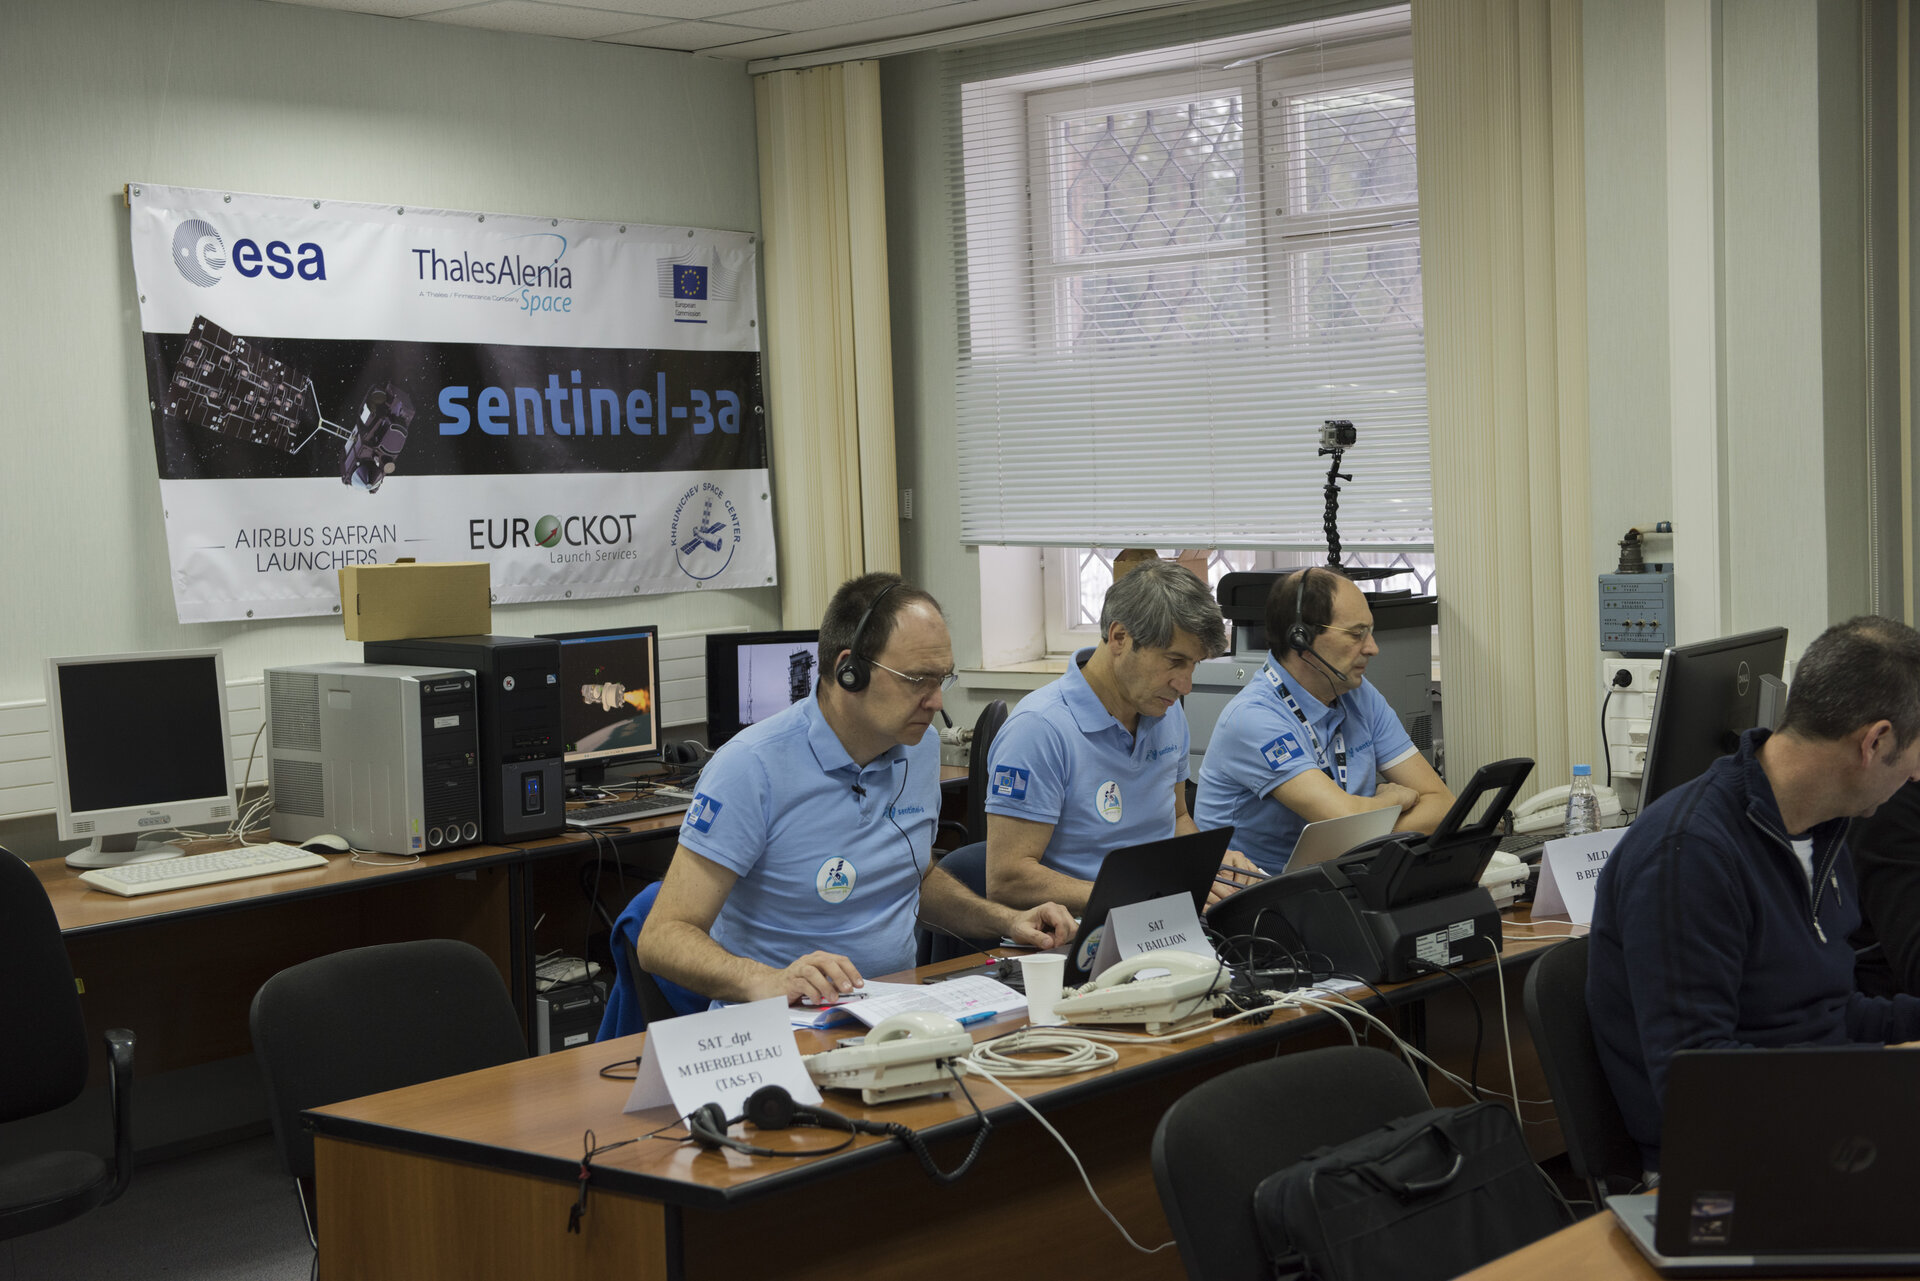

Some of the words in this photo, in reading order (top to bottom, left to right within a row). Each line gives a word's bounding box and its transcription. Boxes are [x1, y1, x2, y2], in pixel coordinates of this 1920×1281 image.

[232, 238, 327, 281] esa
[412, 248, 572, 289] ThalesAlenia
[520, 289, 572, 316] Space
[438, 370, 741, 436] sentinel-3a
[671, 484, 699, 546] KHRUNICHEV
[703, 482, 724, 499] SPACE
[724, 500, 741, 543] CENTER
[235, 527, 314, 549] AIRBUS
[322, 524, 397, 546] SAFRAN
[550, 550, 591, 564] Launch
[595, 550, 638, 562] Services
[1576, 871, 1584, 881] B
[1148, 919, 1165, 932] SAT
[1136, 942, 1144, 953] Y
[1144, 933, 1187, 951] BAILLION
[697, 1031, 752, 1051] SAT_dpt
[678, 1064, 692, 1078] M
[693, 1045, 783, 1074] HERBELLEAU
[715, 1071, 763, 1092] (TAS-F)
